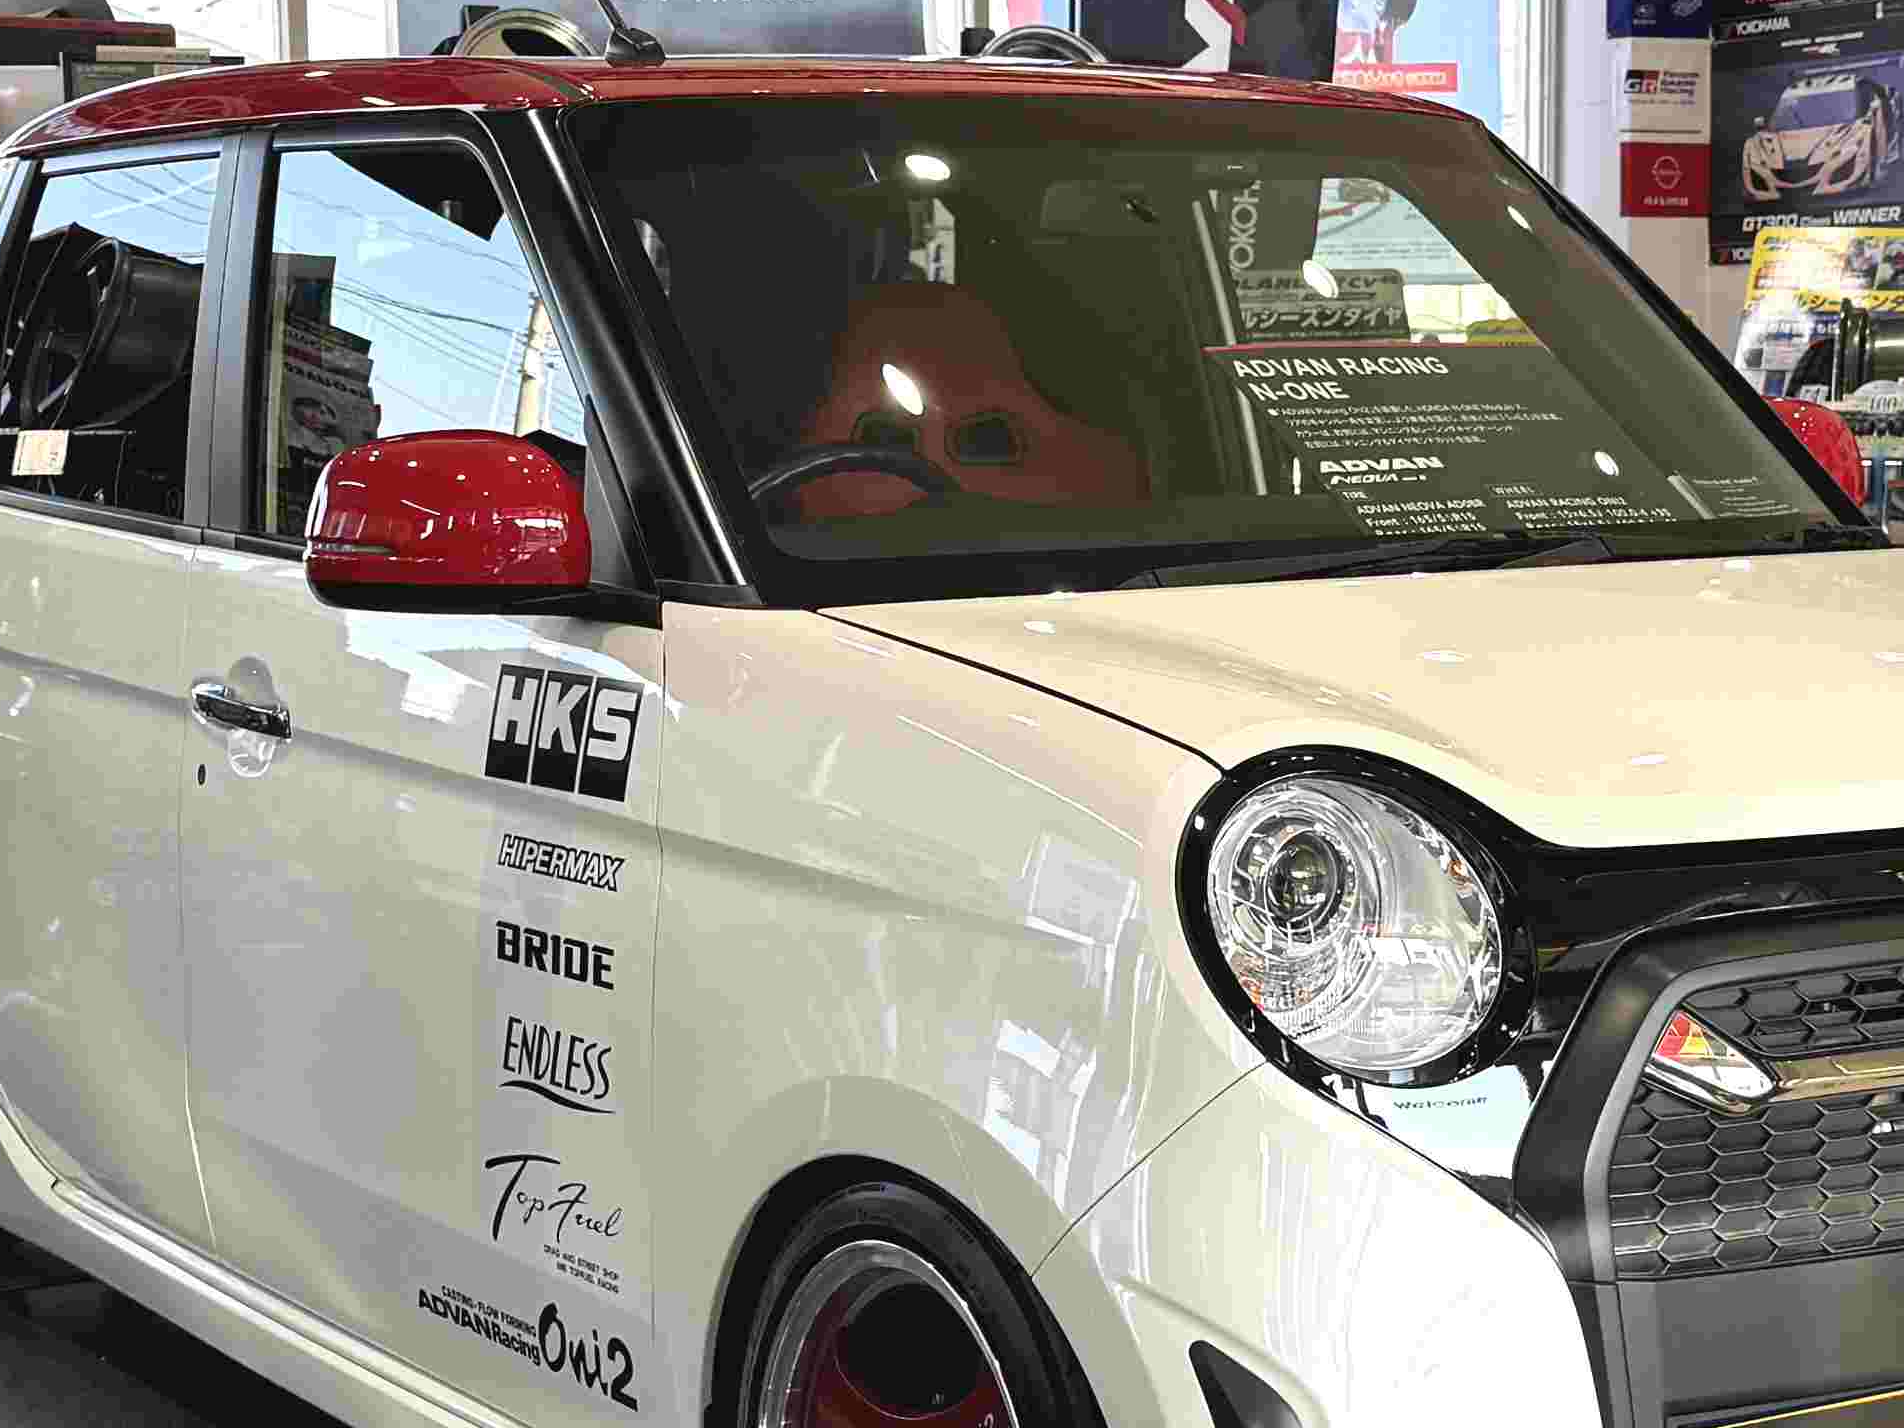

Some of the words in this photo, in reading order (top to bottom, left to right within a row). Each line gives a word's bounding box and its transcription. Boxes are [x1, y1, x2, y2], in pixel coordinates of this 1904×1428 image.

[1832, 205, 1902, 226] WINNER
[1232, 357, 1339, 378] ADVAN
[1337, 356, 1449, 378] RACING
[1248, 381, 1351, 402] N-ONE
[1319, 456, 1446, 474] ADVAN
[490, 672, 641, 764] HKS
[497, 833, 625, 893] HIPERMAX
[496, 920, 616, 991] BRIDE
[501, 1014, 614, 1101] ENDLESS
[484, 1153, 562, 1242] Top
[547, 1182, 626, 1244] Fuel
[538, 1302, 640, 1414] Oni2
